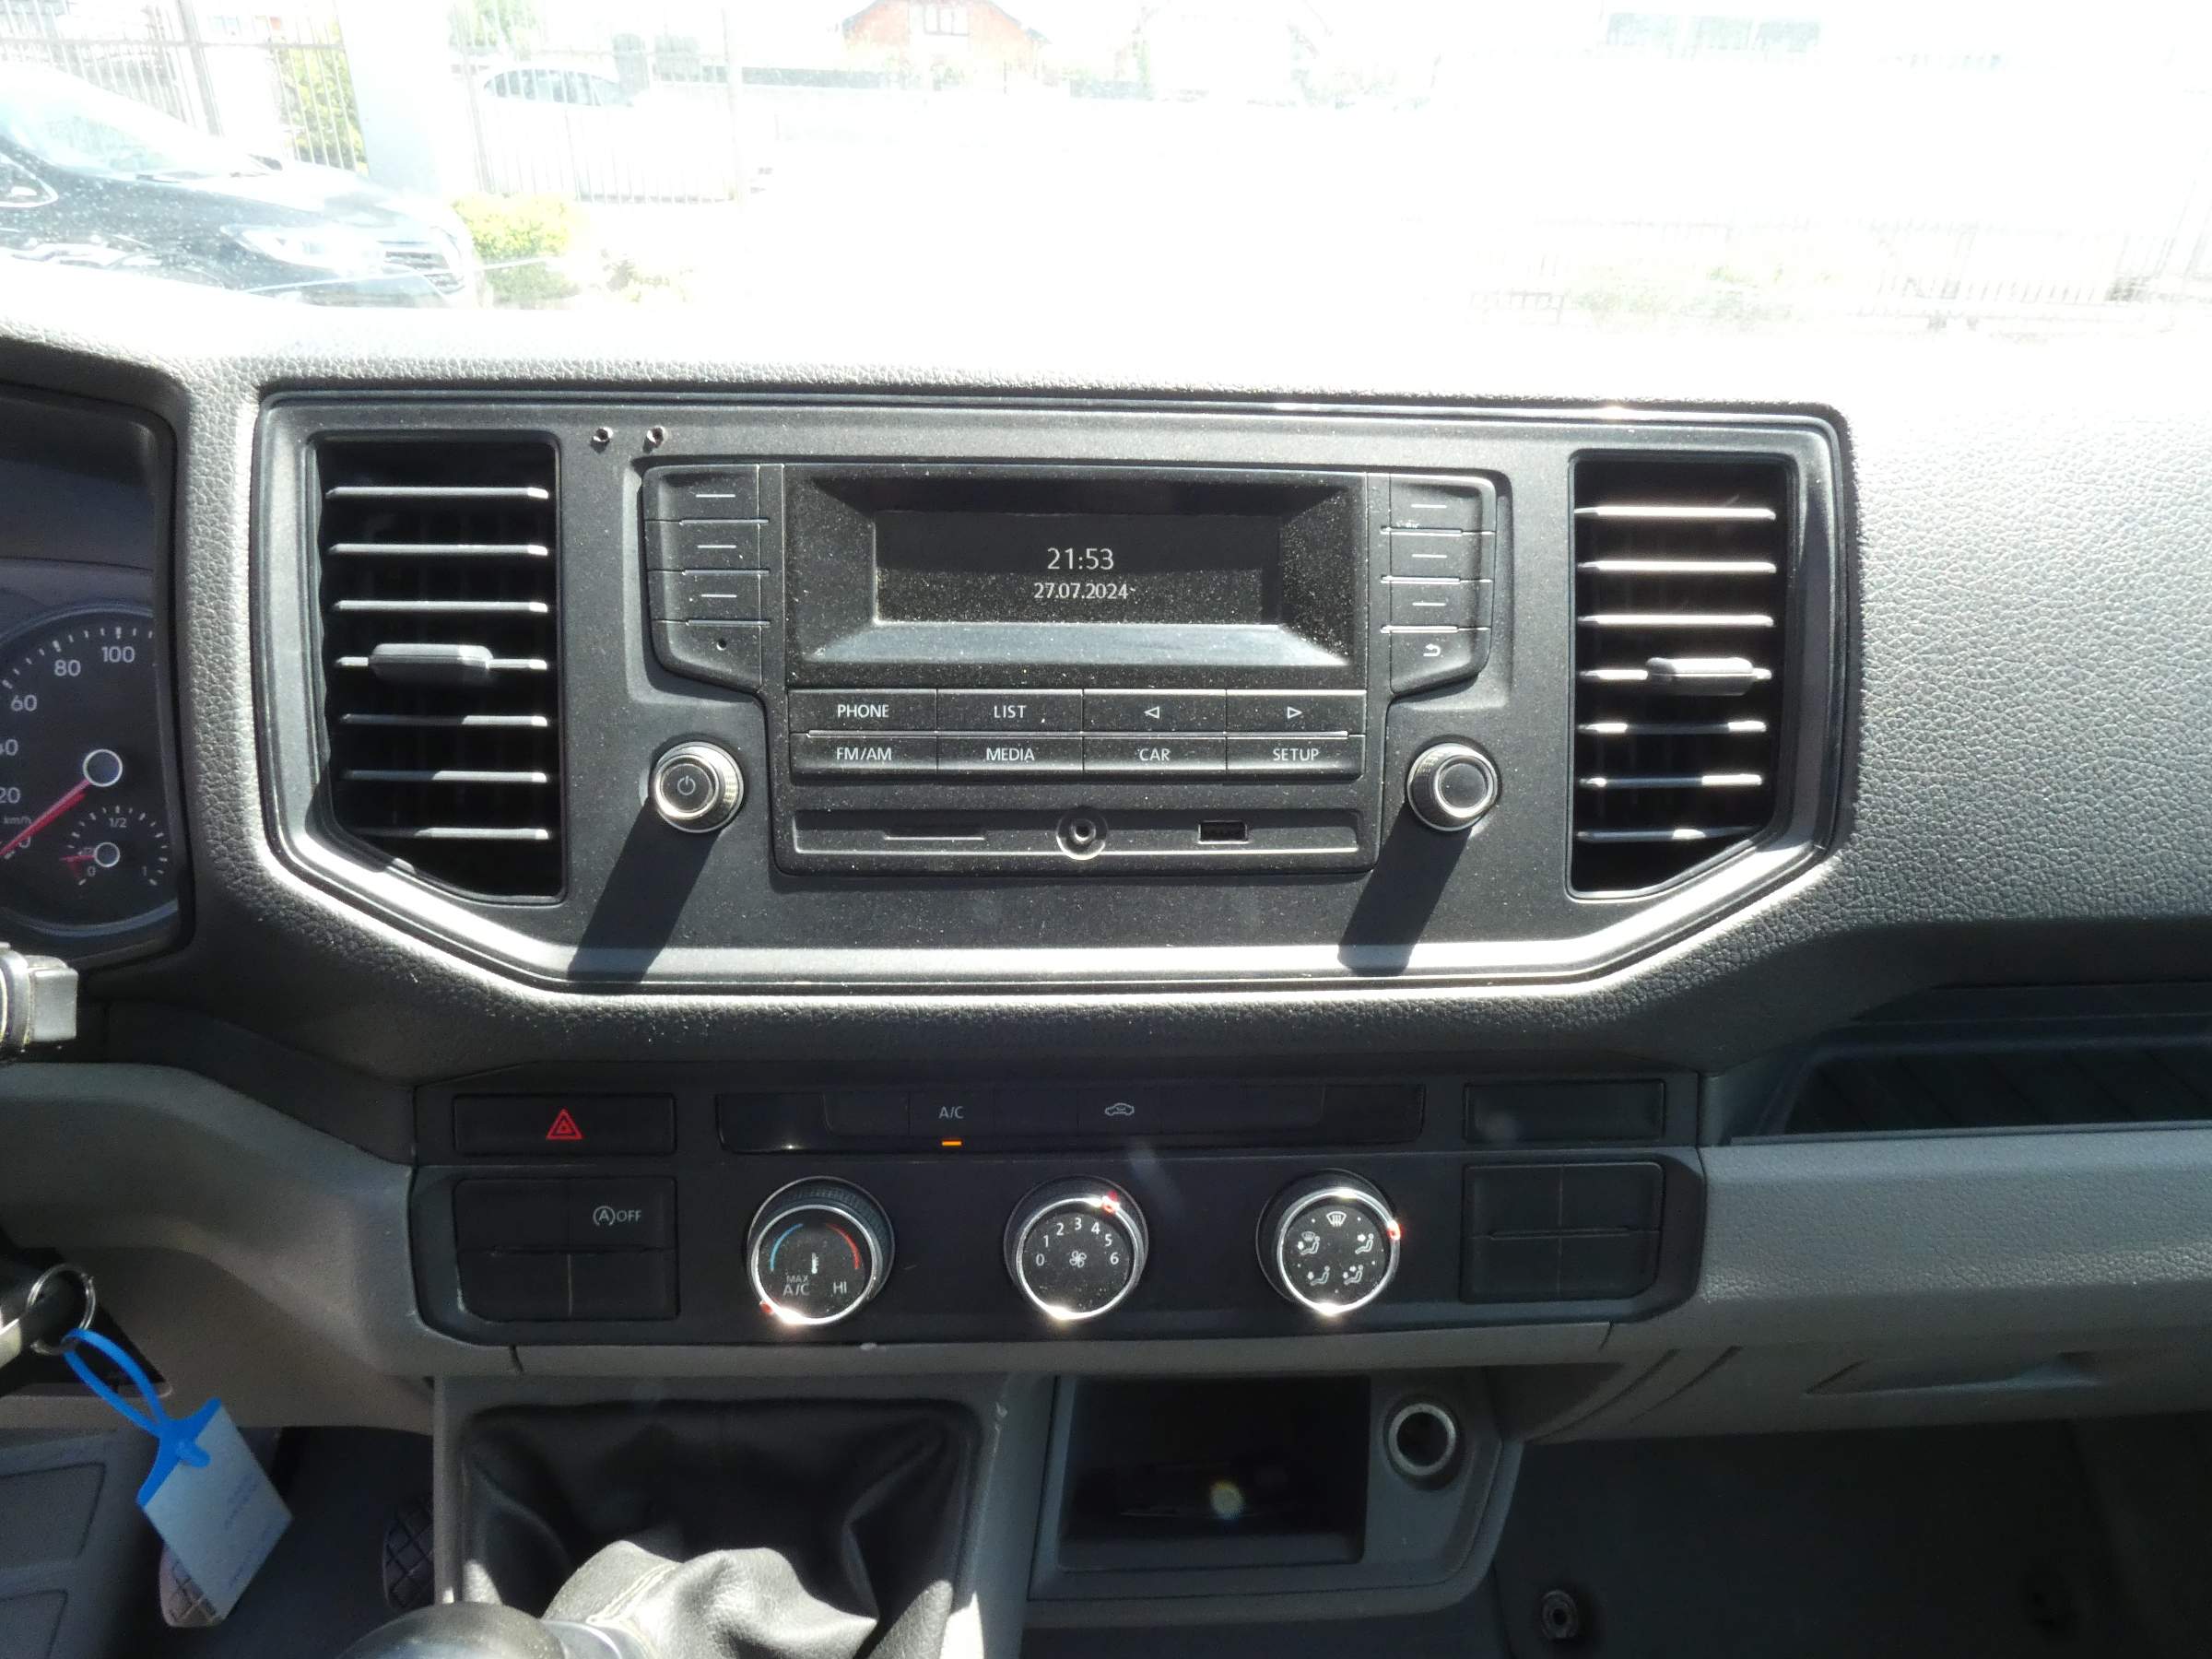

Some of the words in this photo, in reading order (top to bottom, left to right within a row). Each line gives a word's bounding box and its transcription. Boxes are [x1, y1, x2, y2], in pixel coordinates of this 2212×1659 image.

[1047, 547, 1114, 570] 21:53
[1033, 582, 1128, 599] 27.07.2024
[101, 645, 135, 663] 100
[53, 659, 81, 677] 80
[10, 694, 38, 712] 60
[837, 703, 890, 720] PHONE
[993, 704, 1027, 720] LIST
[836, 747, 892, 762] FM/AM
[985, 747, 1036, 762] MEDIA
[1139, 747, 1171, 762] CAR
[1272, 747, 1320, 763] SETUP
[109, 818, 127, 829] 1/2
[938, 1105, 964, 1119] A/C
[617, 1209, 641, 1222] OFF
[1035, 1253, 1045, 1266] 0
[1043, 1235, 1050, 1248] 1
[1056, 1222, 1065, 1236] 2
[1074, 1217, 1082, 1230] 3
[1090, 1222, 1100, 1235] 4
[1104, 1233, 1112, 1247] 5
[1110, 1252, 1119, 1265] 6
[786, 1274, 809, 1284] MAX
[783, 1283, 810, 1296] A/C
[832, 1281, 848, 1294] HI
